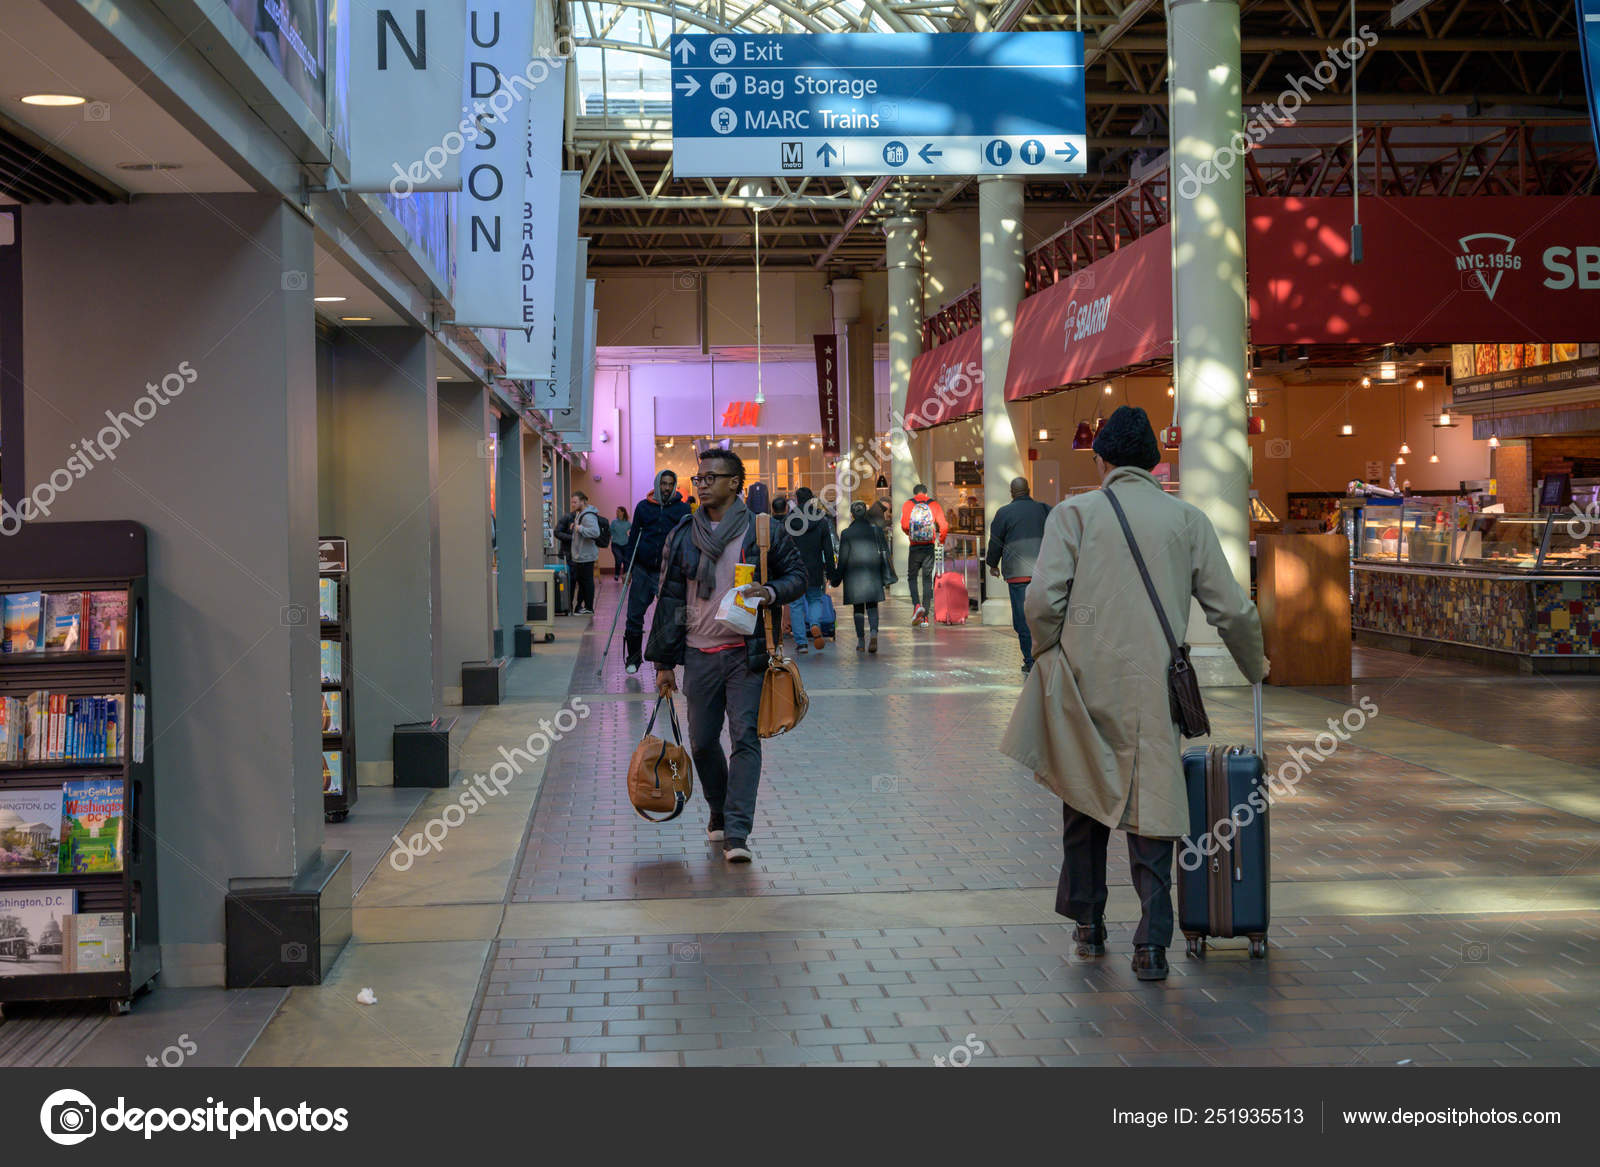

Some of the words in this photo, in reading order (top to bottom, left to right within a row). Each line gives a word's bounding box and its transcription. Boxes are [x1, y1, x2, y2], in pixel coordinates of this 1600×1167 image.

[376, 9, 427, 71] N
[743, 41, 783, 61] Exit
[744, 75, 784, 99] Bag
[794, 75, 877, 99] Storage
[468, 11, 504, 253] UDSON
[745, 110, 810, 129] MARC
[818, 108, 880, 128] Trains
[783, 144, 801, 162] M
[521, 202, 535, 344] BRADLEY
[1456, 254, 1522, 271] NYC.1956
[1542, 246, 1600, 290] SB
[1074, 294, 1112, 341] SBARRO
[825, 358, 835, 435] PRET
[43, 802, 57, 810] DC
